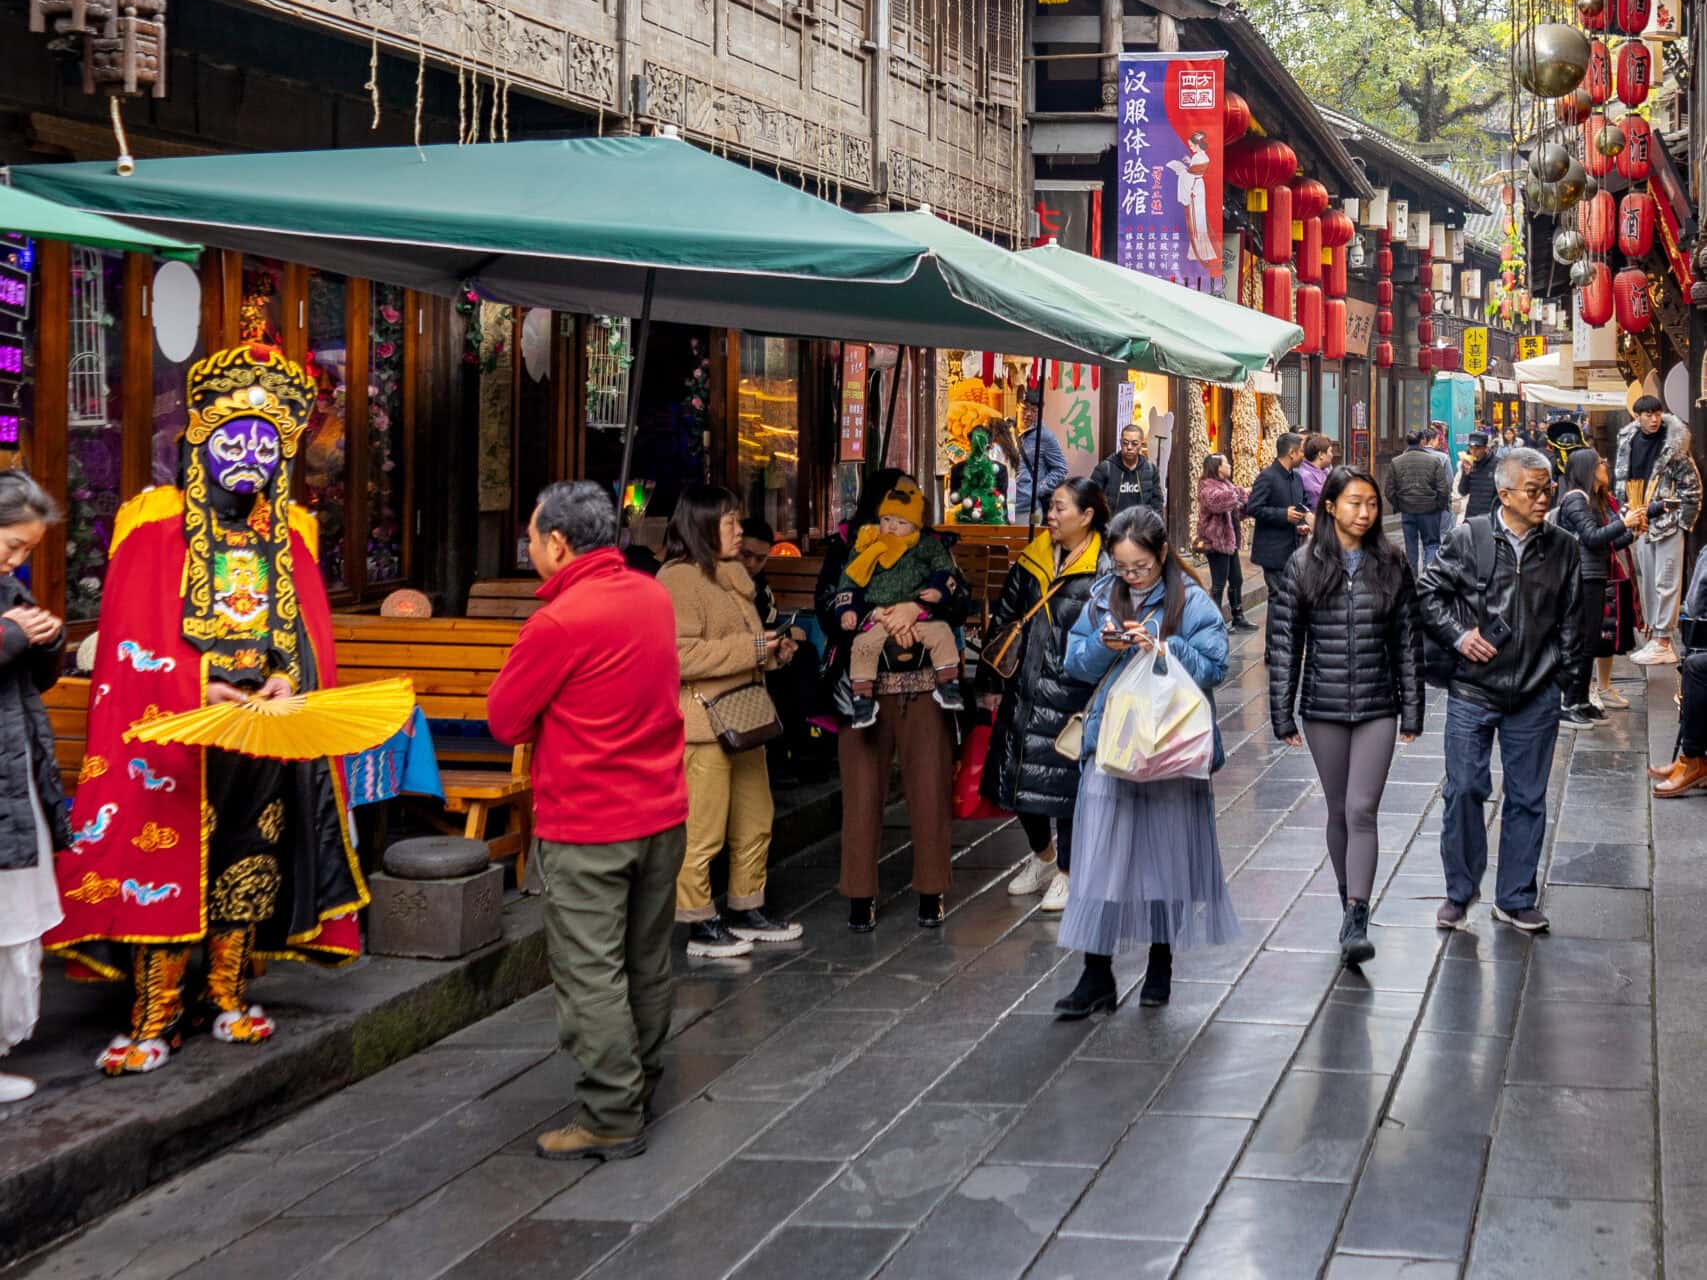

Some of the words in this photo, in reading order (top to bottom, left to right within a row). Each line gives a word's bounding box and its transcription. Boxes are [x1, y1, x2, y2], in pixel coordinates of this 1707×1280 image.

[1122, 68, 1151, 215] 汉服体验馆
[1621, 207, 1641, 240] 酒
[1467, 330, 1484, 370] 小喜串
